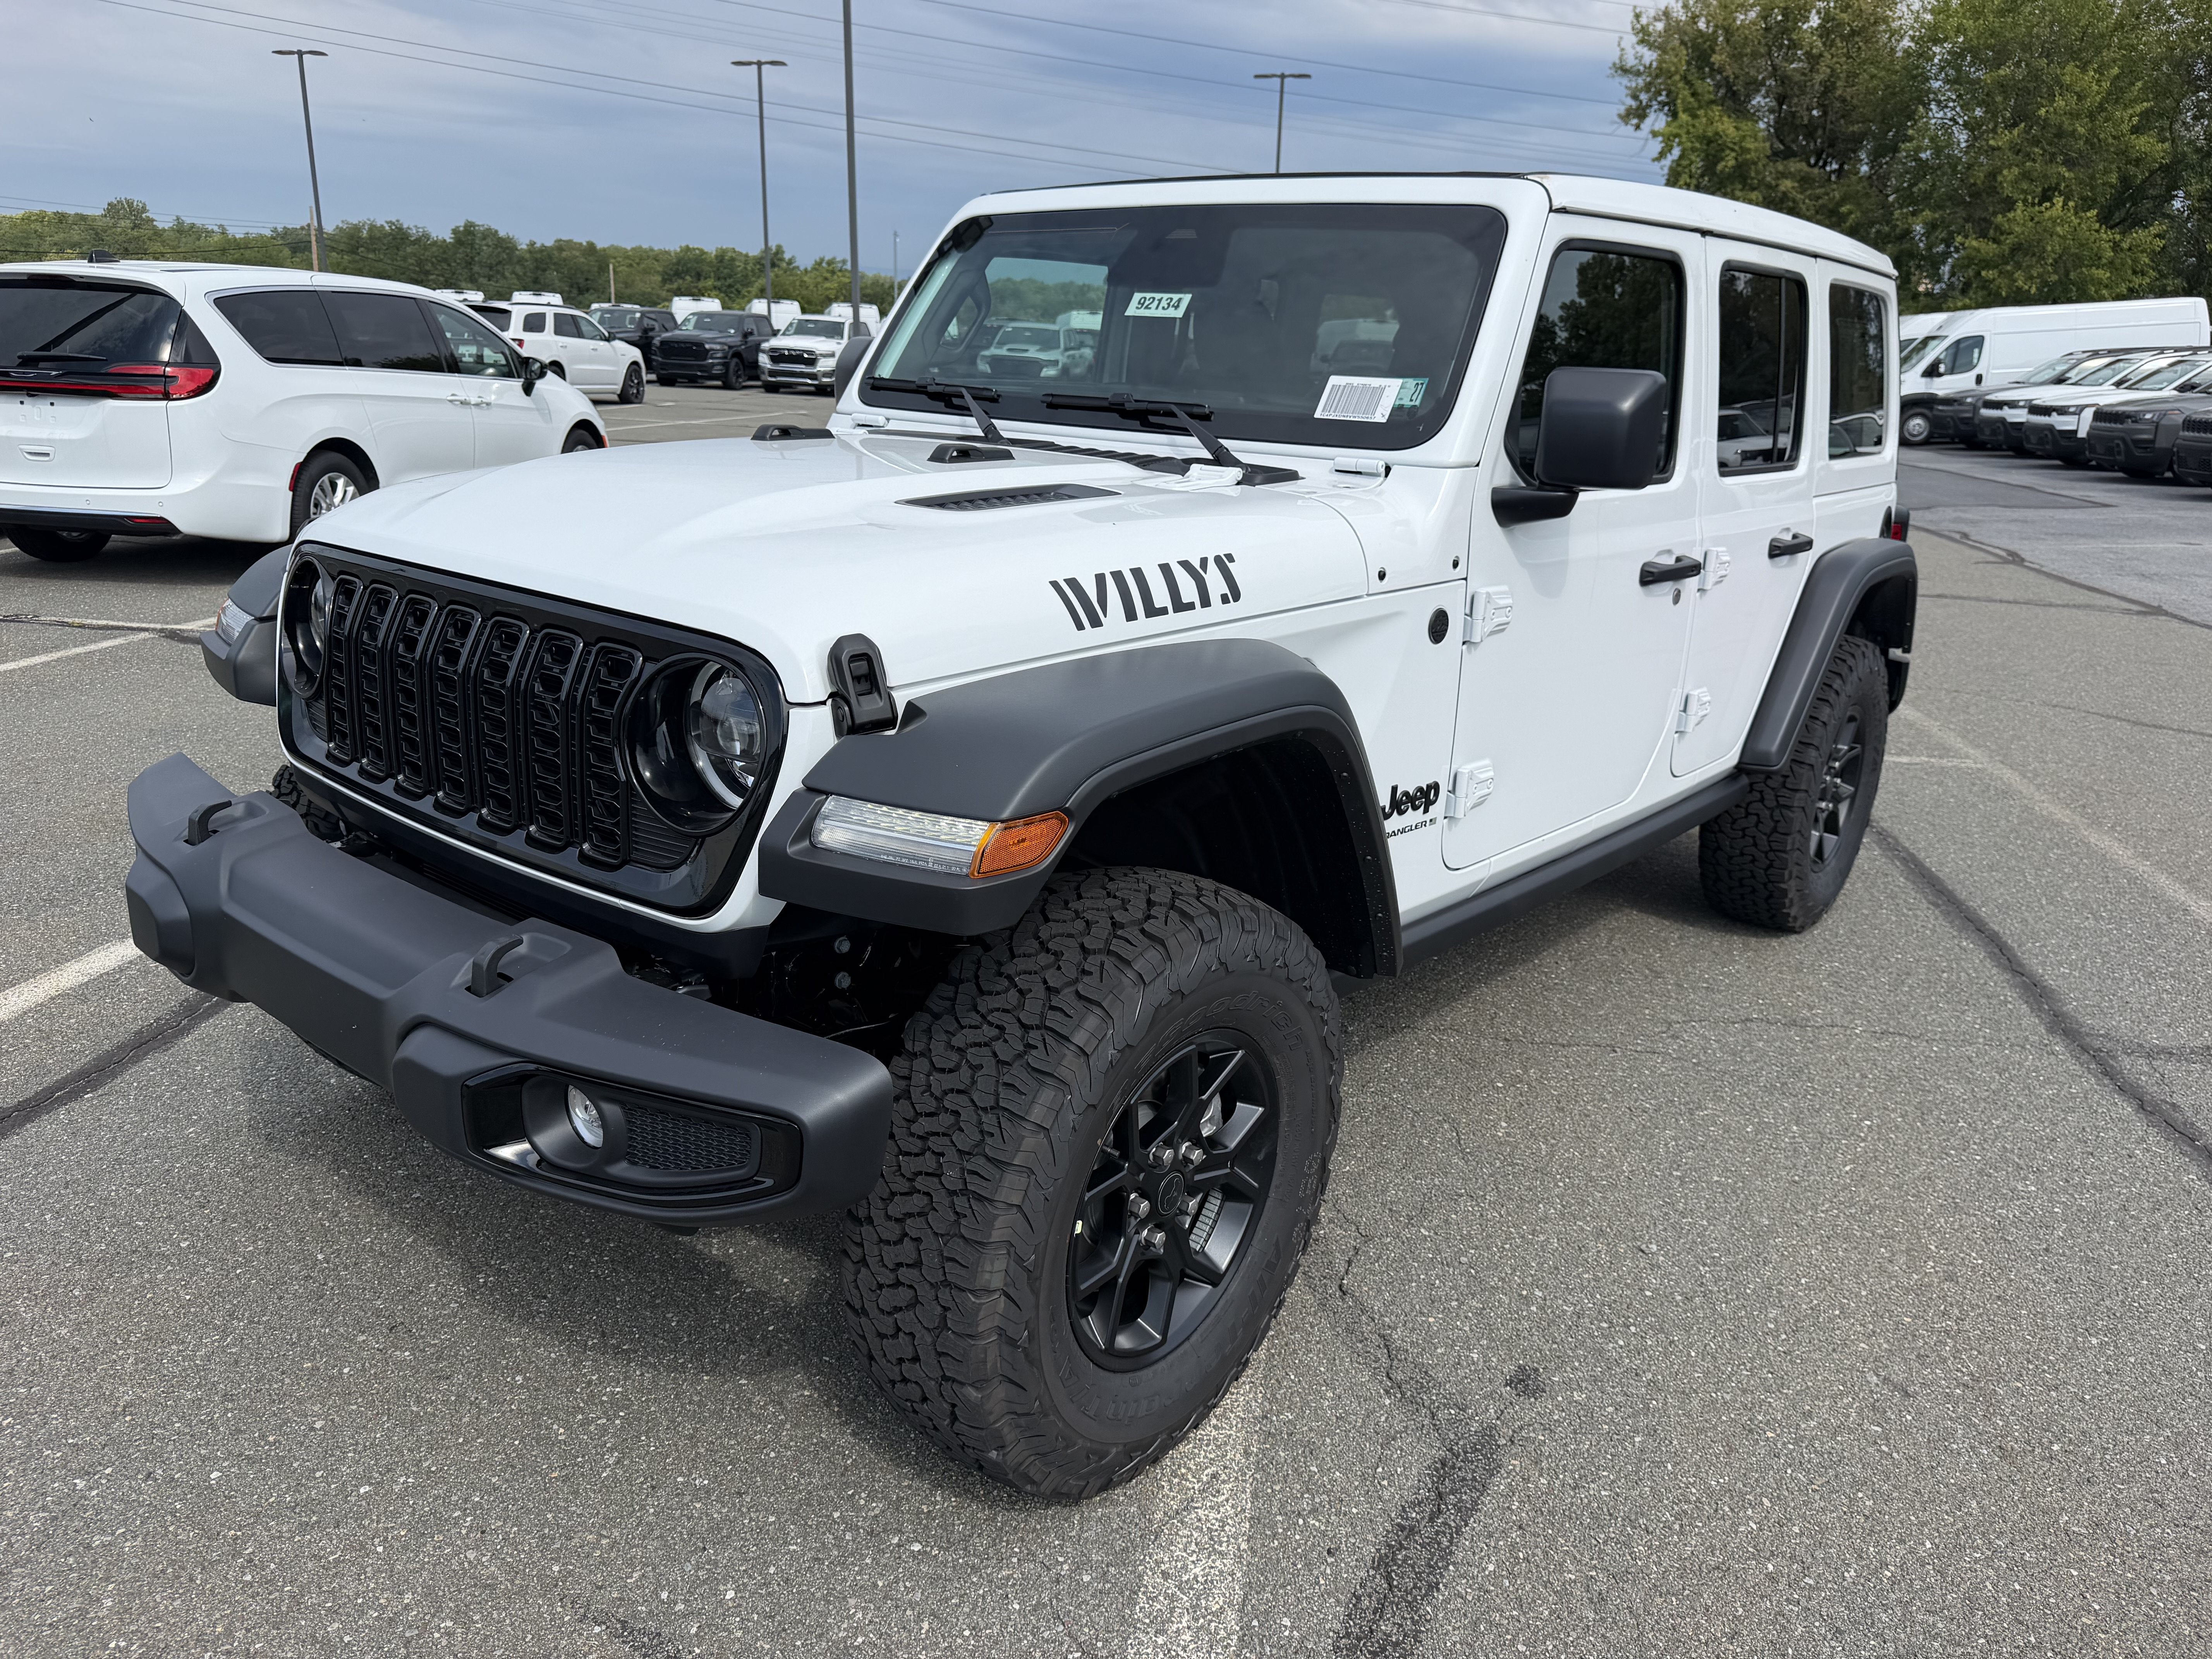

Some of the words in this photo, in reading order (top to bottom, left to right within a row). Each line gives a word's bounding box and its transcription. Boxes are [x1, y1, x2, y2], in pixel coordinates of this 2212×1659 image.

[1135, 296, 1184, 311] 92134
[1409, 382, 1425, 402] 27
[1049, 553, 1241, 631] WILLYS
[1381, 780, 1440, 821] Jeep
[1386, 820, 1427, 839] RANGLER
